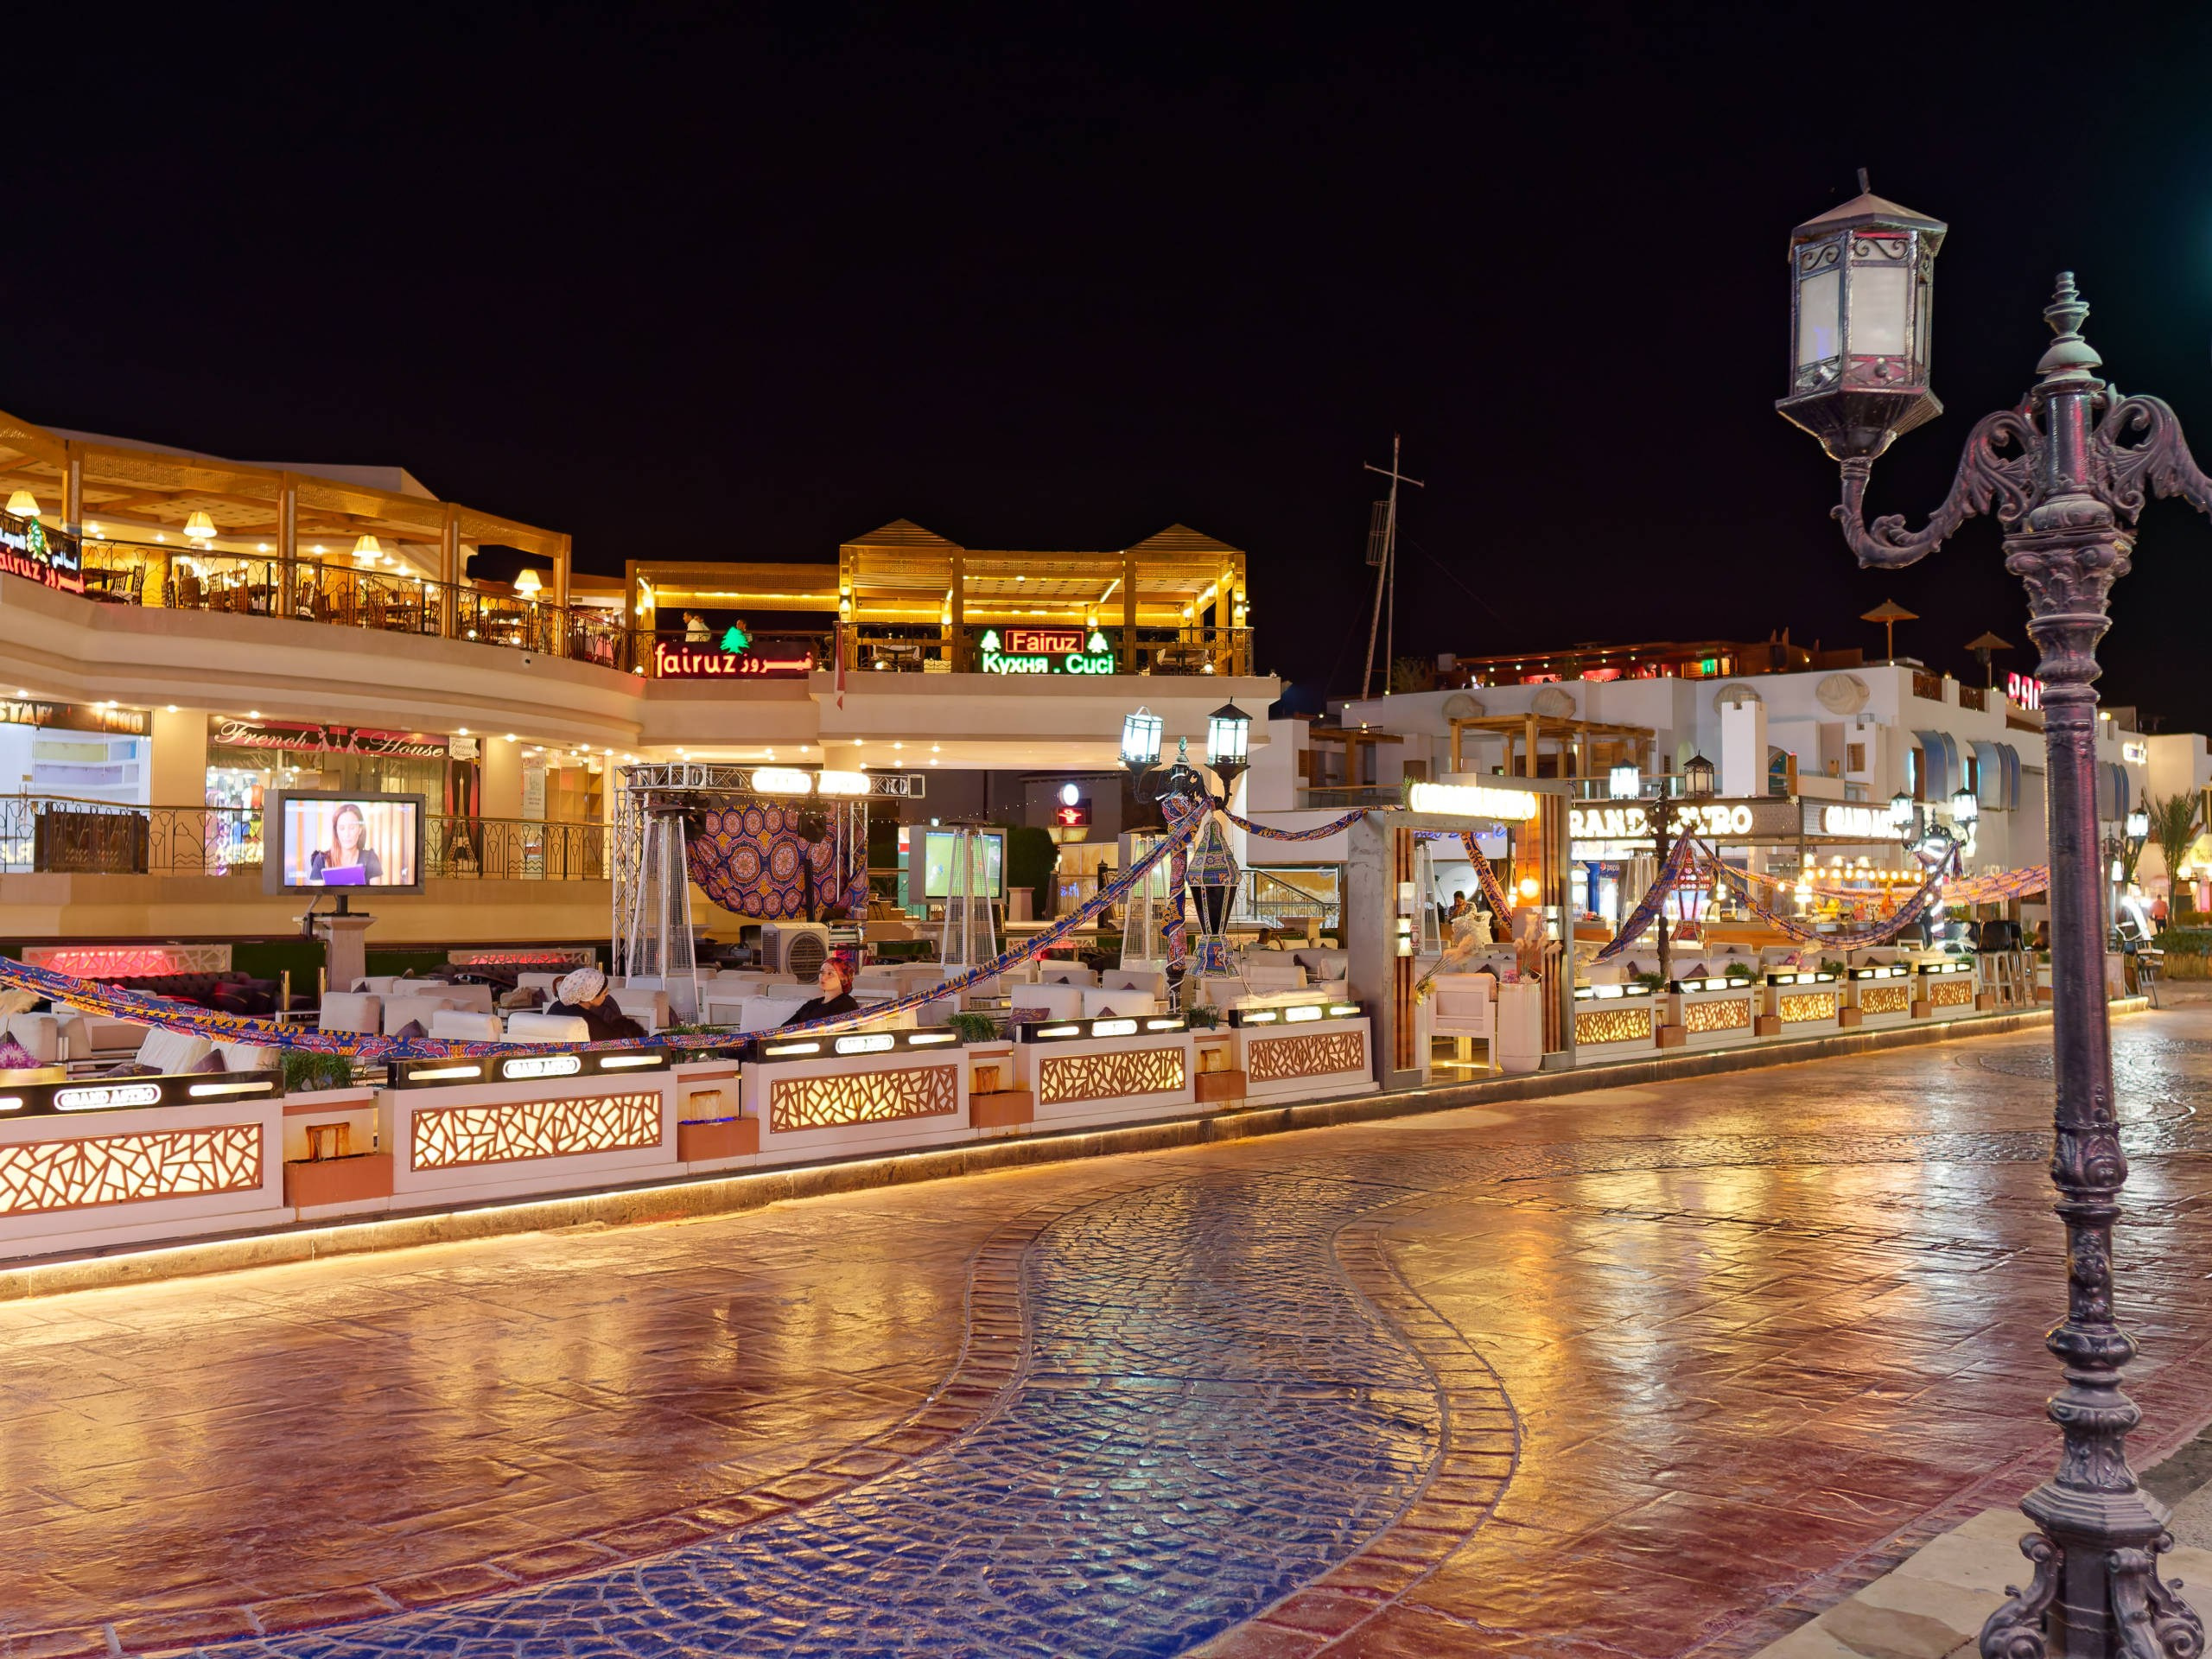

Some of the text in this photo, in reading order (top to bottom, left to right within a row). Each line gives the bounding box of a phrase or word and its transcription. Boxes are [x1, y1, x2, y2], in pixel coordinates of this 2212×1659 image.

[1013, 632, 1077, 652] Fairuz
[655, 643, 736, 677] fairuz
[982, 652, 1048, 676] Кухня
[1065, 653, 1114, 674] Cuci
[213, 718, 309, 748] French
[365, 732, 444, 758] House
[1569, 807, 1648, 837] RAND
